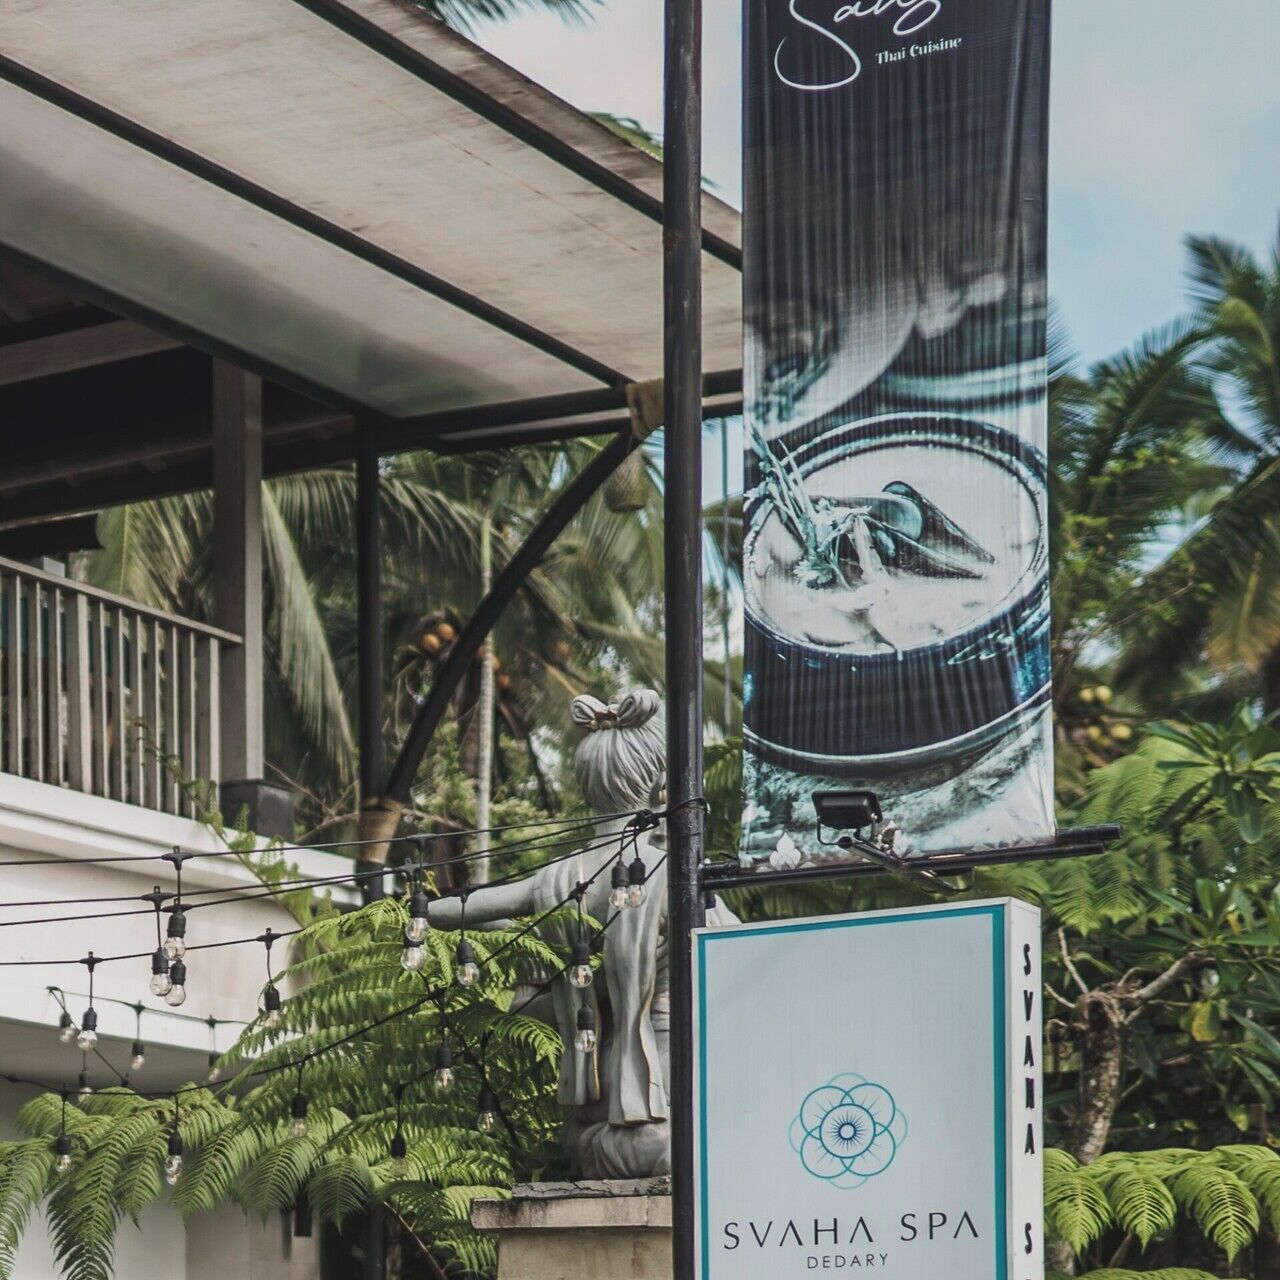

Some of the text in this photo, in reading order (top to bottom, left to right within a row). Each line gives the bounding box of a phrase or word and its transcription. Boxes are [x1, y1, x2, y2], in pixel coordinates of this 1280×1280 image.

[875, 37, 962, 65] Thai Cuisine
[723, 1210, 979, 1250] SVAHA SPA
[807, 1253, 888, 1269] DEDARY
